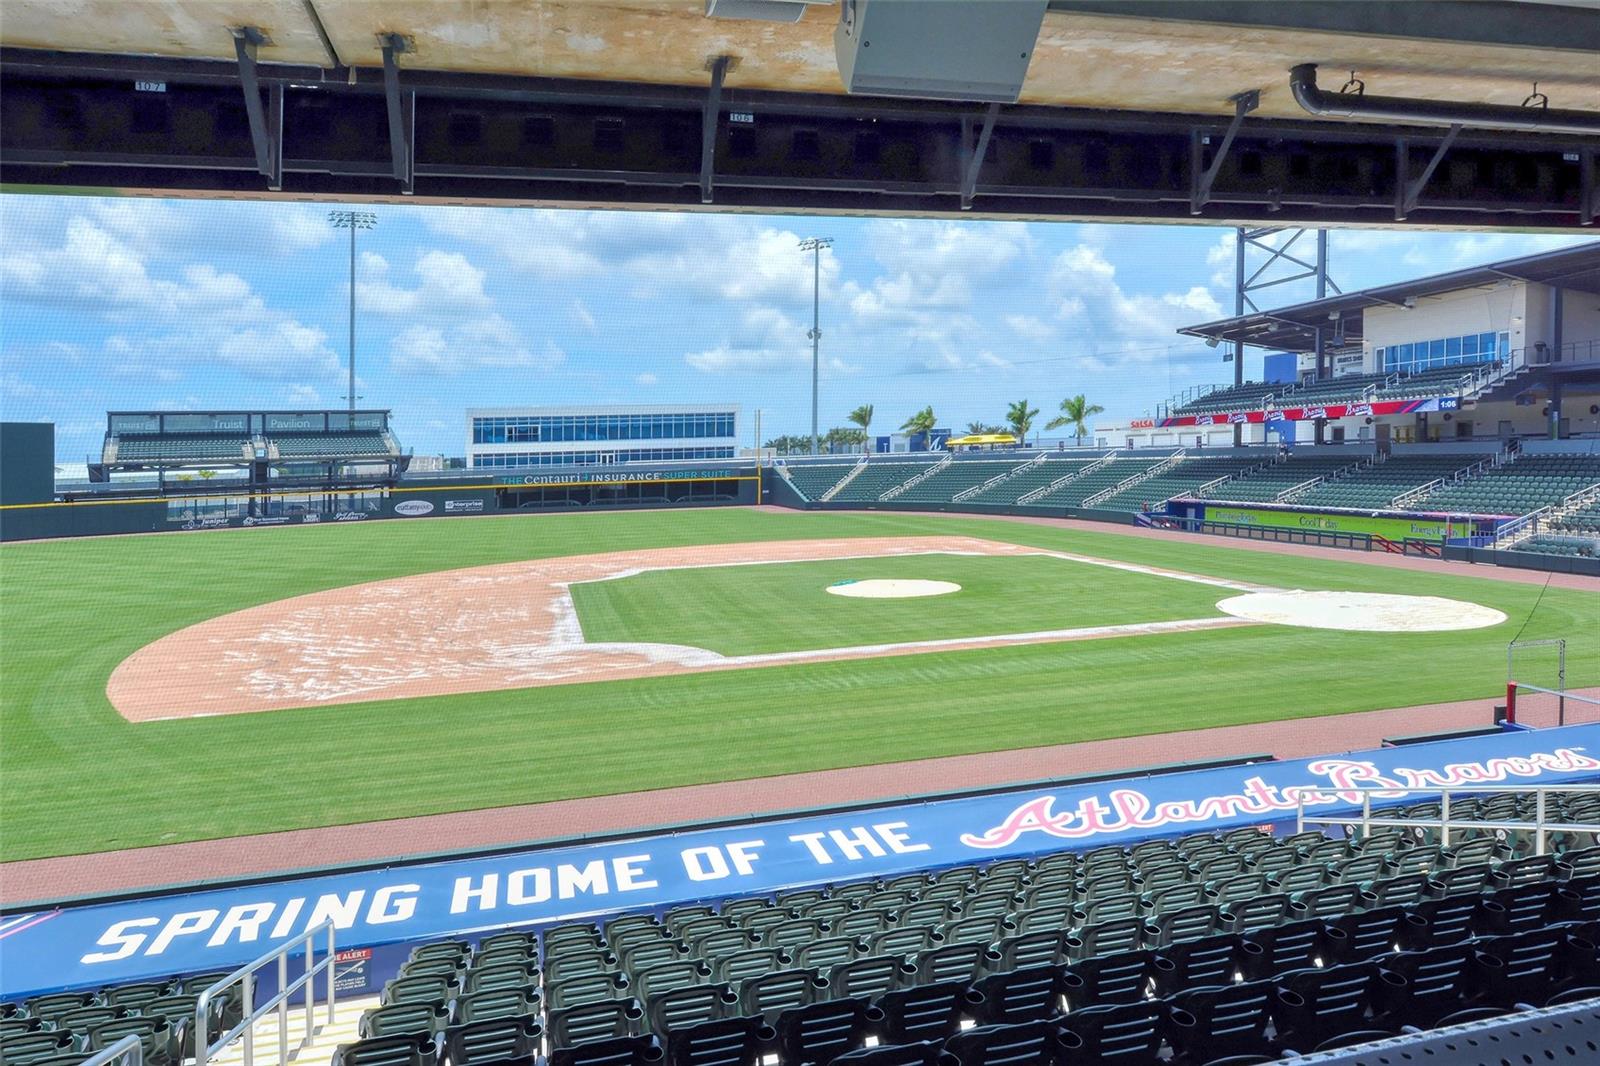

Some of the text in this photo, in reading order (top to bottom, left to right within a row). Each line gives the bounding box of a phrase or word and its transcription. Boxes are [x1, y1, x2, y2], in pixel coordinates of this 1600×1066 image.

[137, 81, 160, 91] 107
[1440, 400, 1457, 408] 1:06
[213, 419, 311, 429] Truist Pavilion
[501, 470, 732, 485] THE Centauri INSURANCE SUPER SUITE
[80, 749, 1600, 964] SPRING HOME OF THE Atlanta Braves
[342, 950, 367, 960] ALERT
